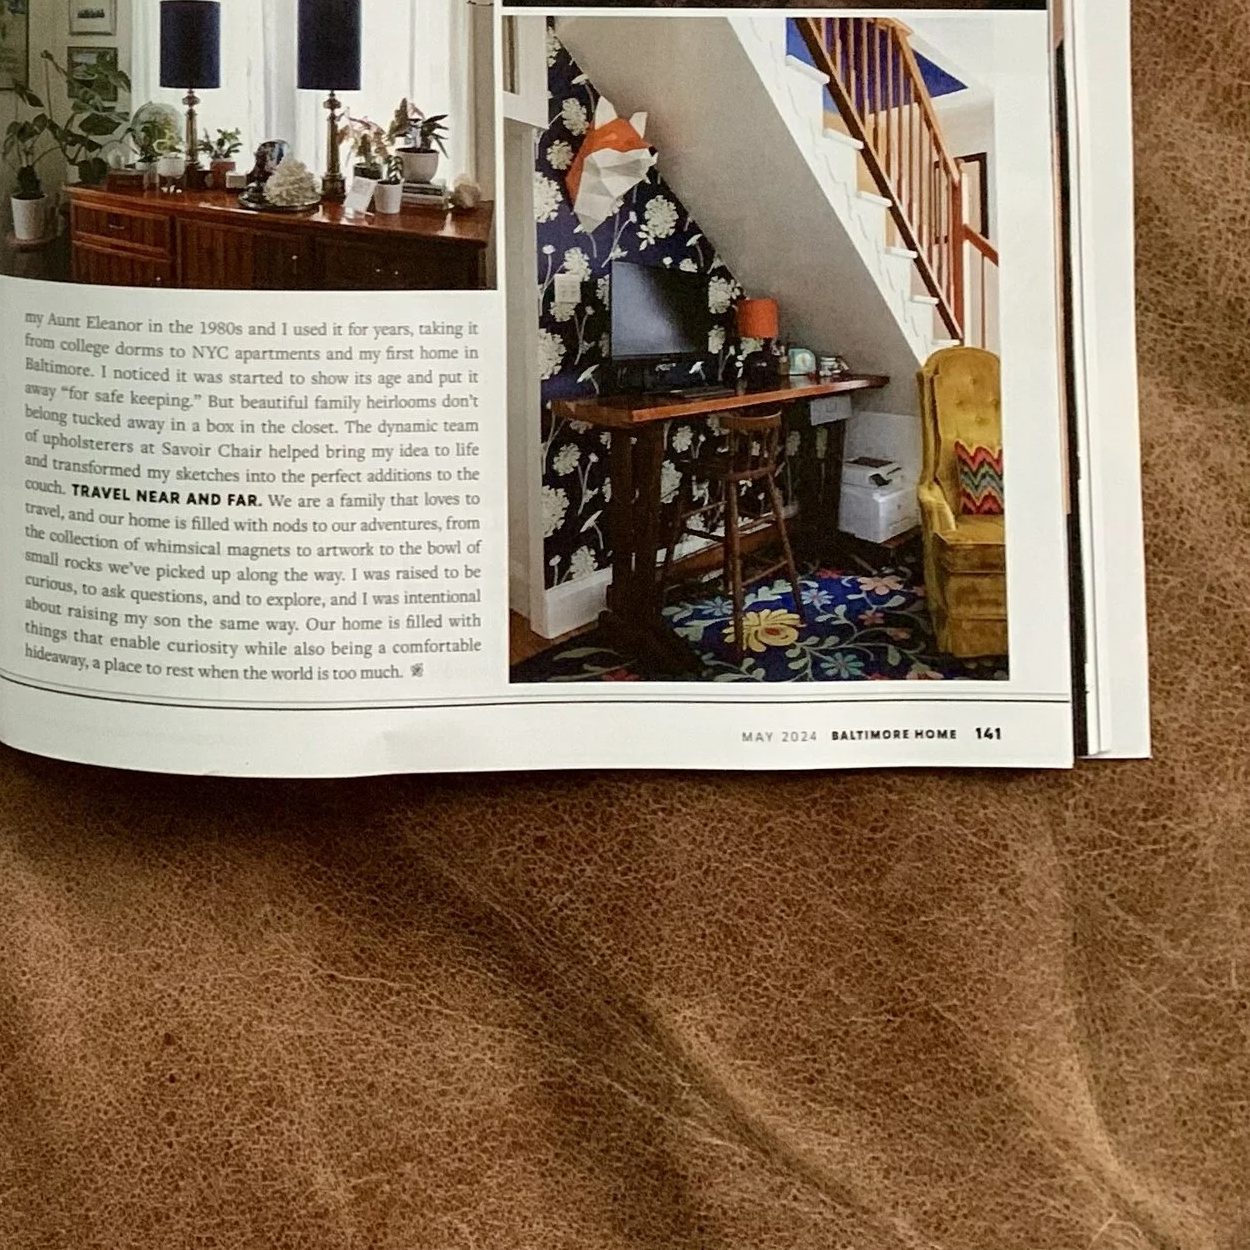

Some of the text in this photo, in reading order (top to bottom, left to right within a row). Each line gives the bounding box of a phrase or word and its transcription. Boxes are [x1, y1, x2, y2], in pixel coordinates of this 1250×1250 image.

[24, 332, 479, 364] from college dorms to NYC apartments and my first home in
[25, 479, 480, 510] couch. TRAVEL NEAR AND FAR. We are a family that loves to
[24, 524, 482, 560] the collection of whimsical magnets to artwork to the bowl of
[742, 727, 1001, 741] MAY 2024 BALTIMORE HOME 141
